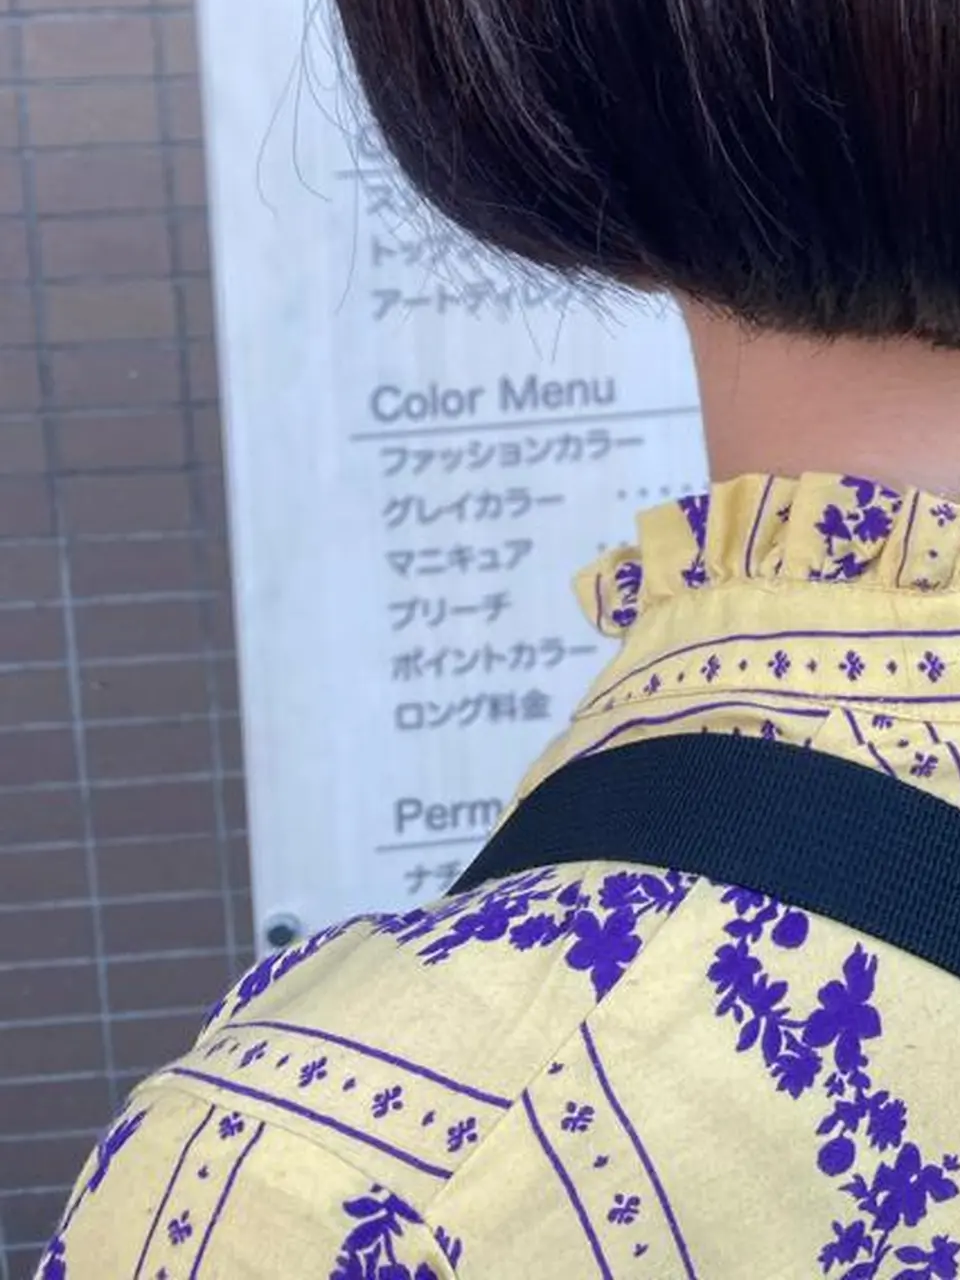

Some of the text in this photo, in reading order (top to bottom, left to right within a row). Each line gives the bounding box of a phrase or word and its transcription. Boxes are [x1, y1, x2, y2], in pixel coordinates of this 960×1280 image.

[369, 372, 616, 423] Color Menu
[379, 428, 645, 477] ファッションカラー
[381, 486, 565, 529] グレイカラー
[384, 538, 533, 578] マニキュア
[391, 636, 598, 682] ポイントカラー
[394, 687, 551, 730] ロング料金
[395, 798, 503, 835] Perm
